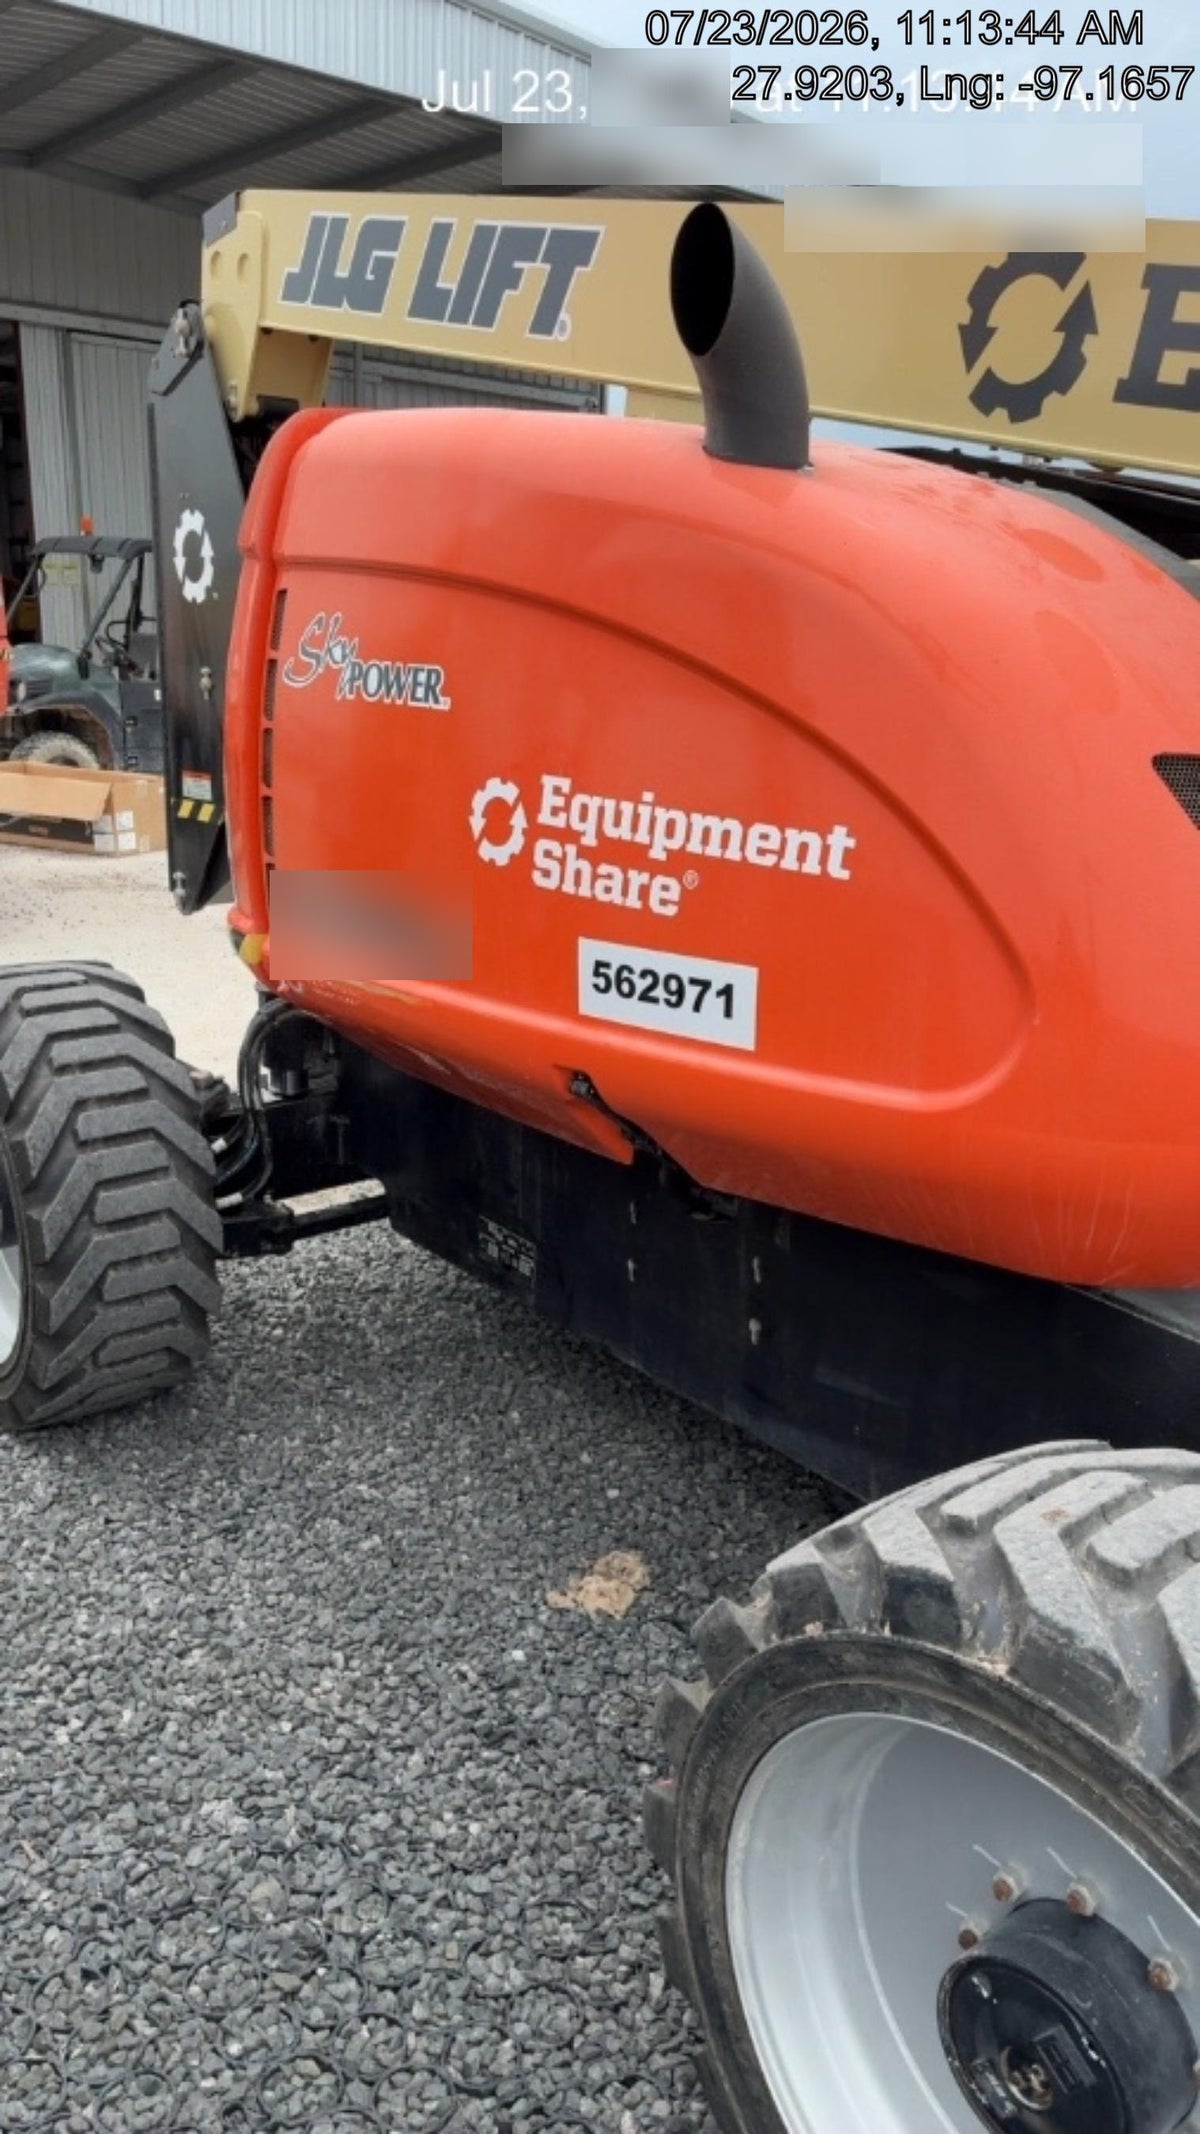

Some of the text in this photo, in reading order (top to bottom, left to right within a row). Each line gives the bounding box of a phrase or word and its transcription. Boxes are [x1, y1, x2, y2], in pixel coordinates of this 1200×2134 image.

[279, 211, 409, 318] JLG
[537, 774, 856, 880] Equipment
[591, 959, 735, 1019] 562971
